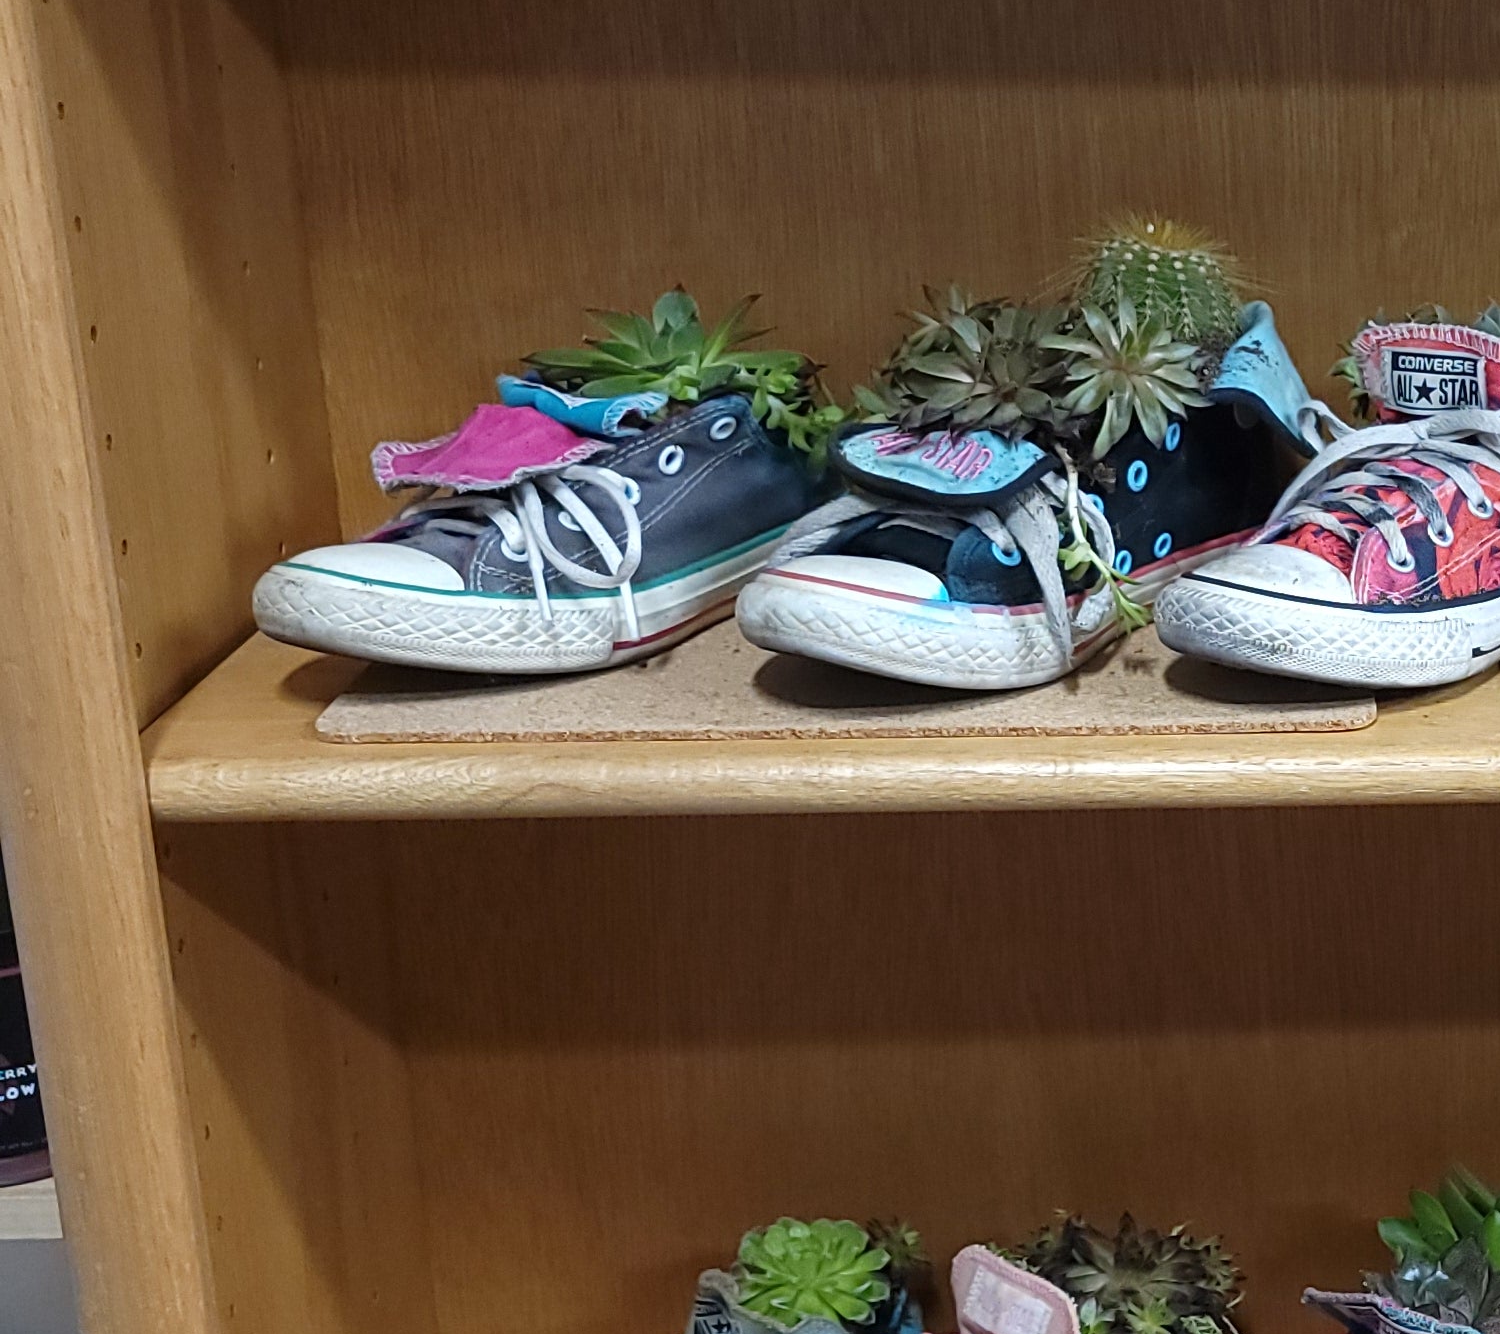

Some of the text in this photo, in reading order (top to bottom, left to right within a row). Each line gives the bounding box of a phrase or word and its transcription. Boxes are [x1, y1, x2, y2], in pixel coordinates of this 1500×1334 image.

[1397, 355, 1476, 374] CONVERSE
[1397, 373, 1479, 406] ALL STAR
